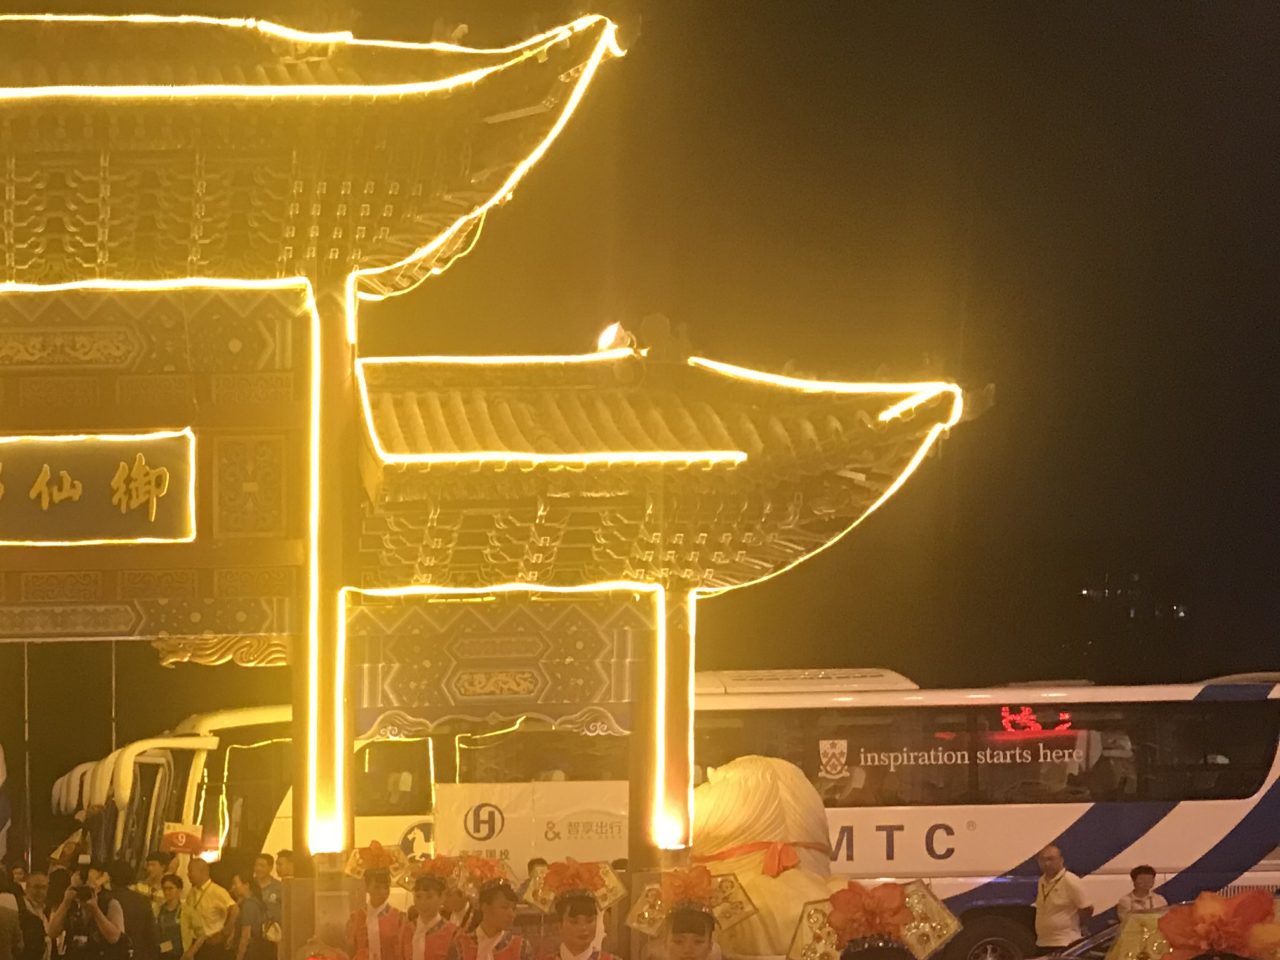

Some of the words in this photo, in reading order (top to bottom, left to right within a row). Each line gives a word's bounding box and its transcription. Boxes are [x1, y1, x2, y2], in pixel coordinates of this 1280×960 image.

[859, 746, 970, 773] inspiration
[976, 746, 1032, 766] starts
[1037, 742, 1084, 764] here
